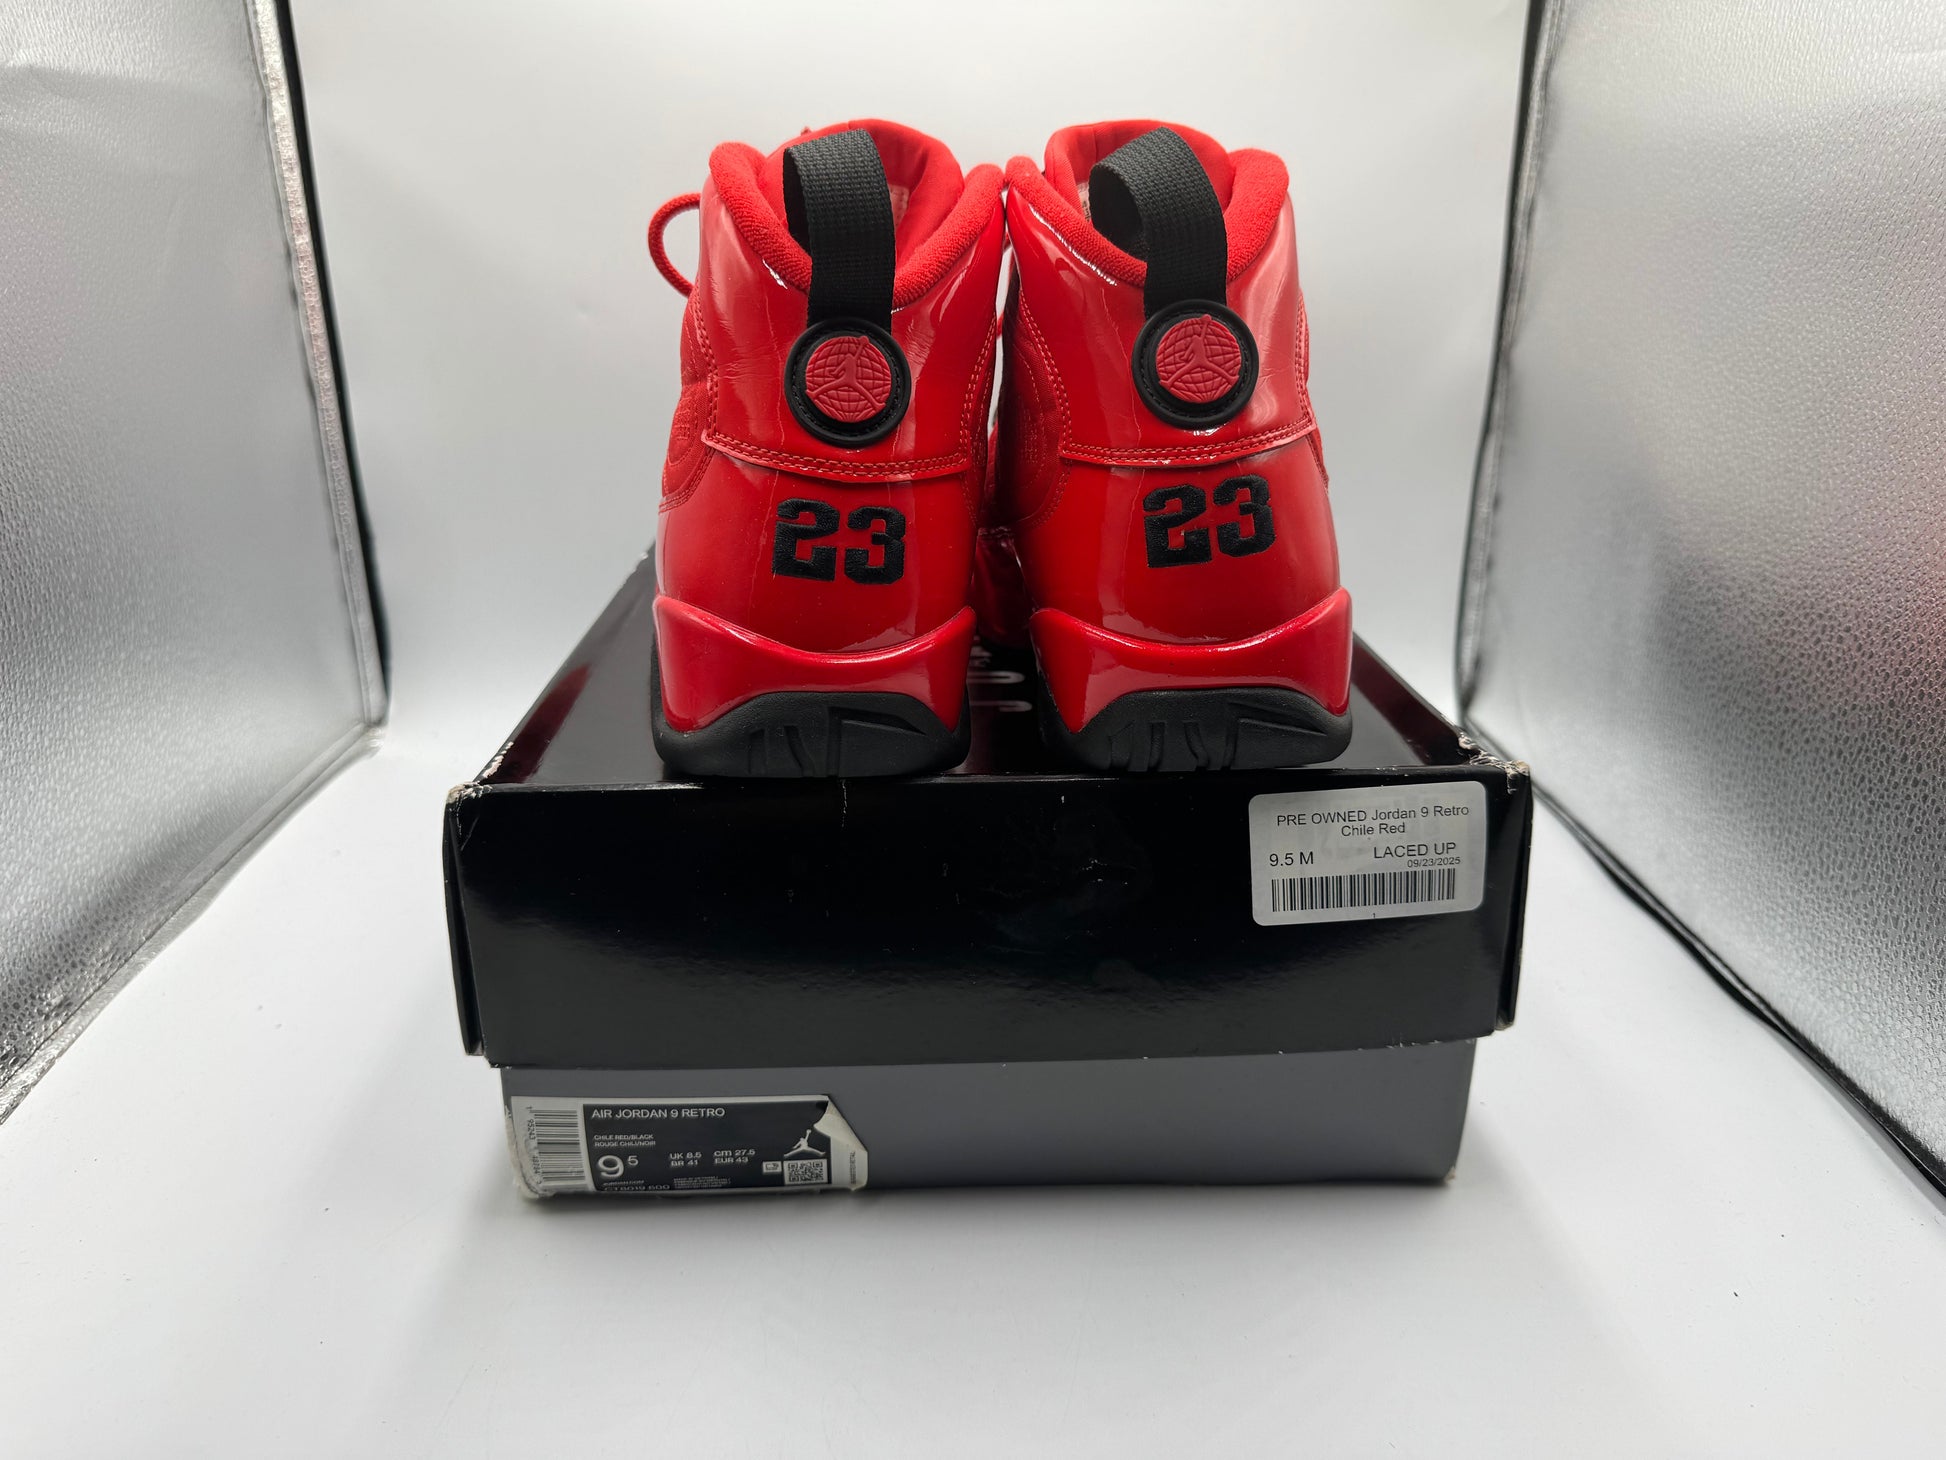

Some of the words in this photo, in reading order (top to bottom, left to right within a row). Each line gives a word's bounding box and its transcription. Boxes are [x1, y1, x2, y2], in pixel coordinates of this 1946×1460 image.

[1141, 473, 1277, 569] 23
[771, 496, 906, 586] 23
[1276, 813, 1307, 826] PRE
[1311, 810, 1367, 825] OWNED
[1371, 807, 1416, 822] Jordan
[1420, 806, 1429, 818] 9
[1433, 805, 1470, 818] Retro
[1341, 823, 1375, 837] Chile
[1379, 822, 1406, 835] Red
[1373, 844, 1429, 859] LACED
[1434, 842, 1457, 855] UP
[1269, 852, 1295, 867] 9.5
[1299, 851, 1315, 865] M
[1406, 856, 1461, 868] 09/23/2025
[591, 1108, 613, 1119] AIR
[615, 1108, 668, 1119] JORDAN
[670, 1108, 679, 1118] 9
[681, 1106, 726, 1118] RETRO
[669, 1152, 684, 1160] UK
[686, 1151, 702, 1159] 8.5
[713, 1149, 733, 1157] cm
[734, 1148, 756, 1156] 27.5
[735, 1156, 749, 1164] 43
[598, 1155, 624, 1177] 9
[627, 1155, 639, 1166] 5
[670, 1159, 685, 1167] BR
[687, 1158, 699, 1166] 41
